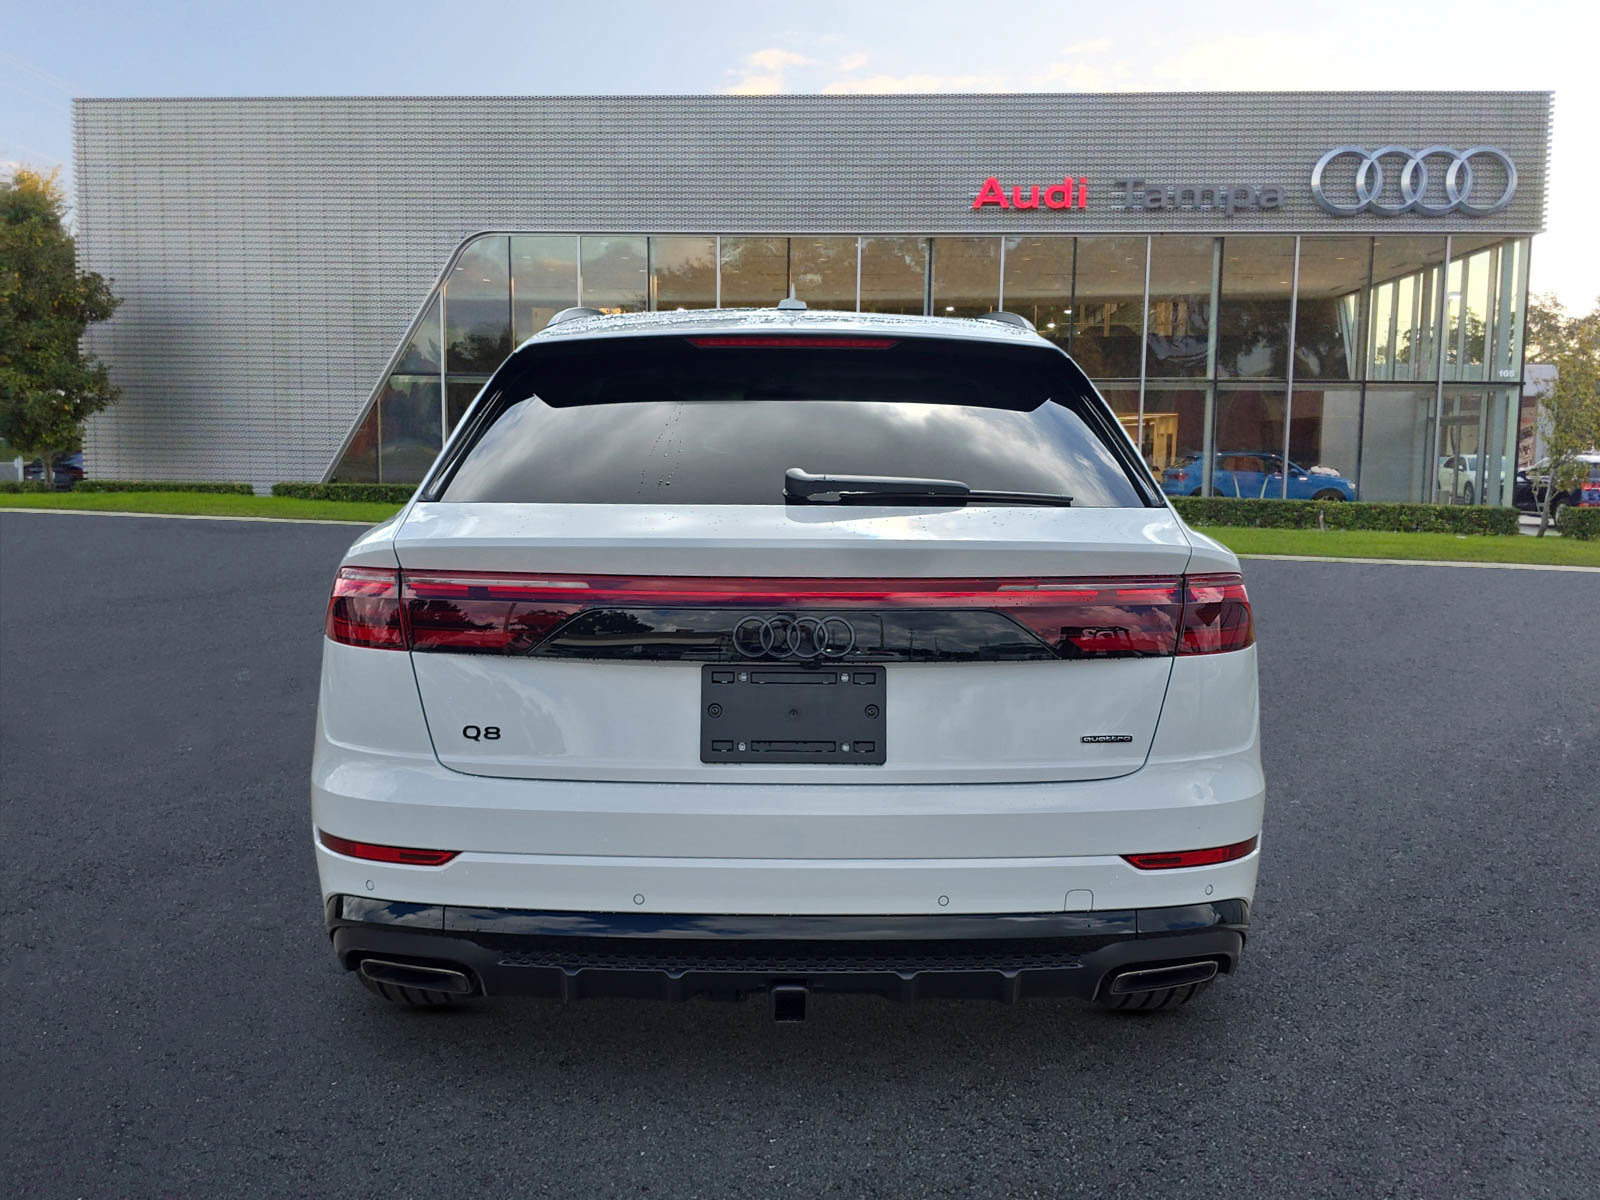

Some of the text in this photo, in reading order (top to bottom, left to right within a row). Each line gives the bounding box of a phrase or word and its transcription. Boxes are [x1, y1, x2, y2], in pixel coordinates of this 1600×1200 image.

[972, 177, 1286, 217] Audi Tampa
[1499, 369, 1515, 378] 105
[462, 725, 501, 742] Q8
